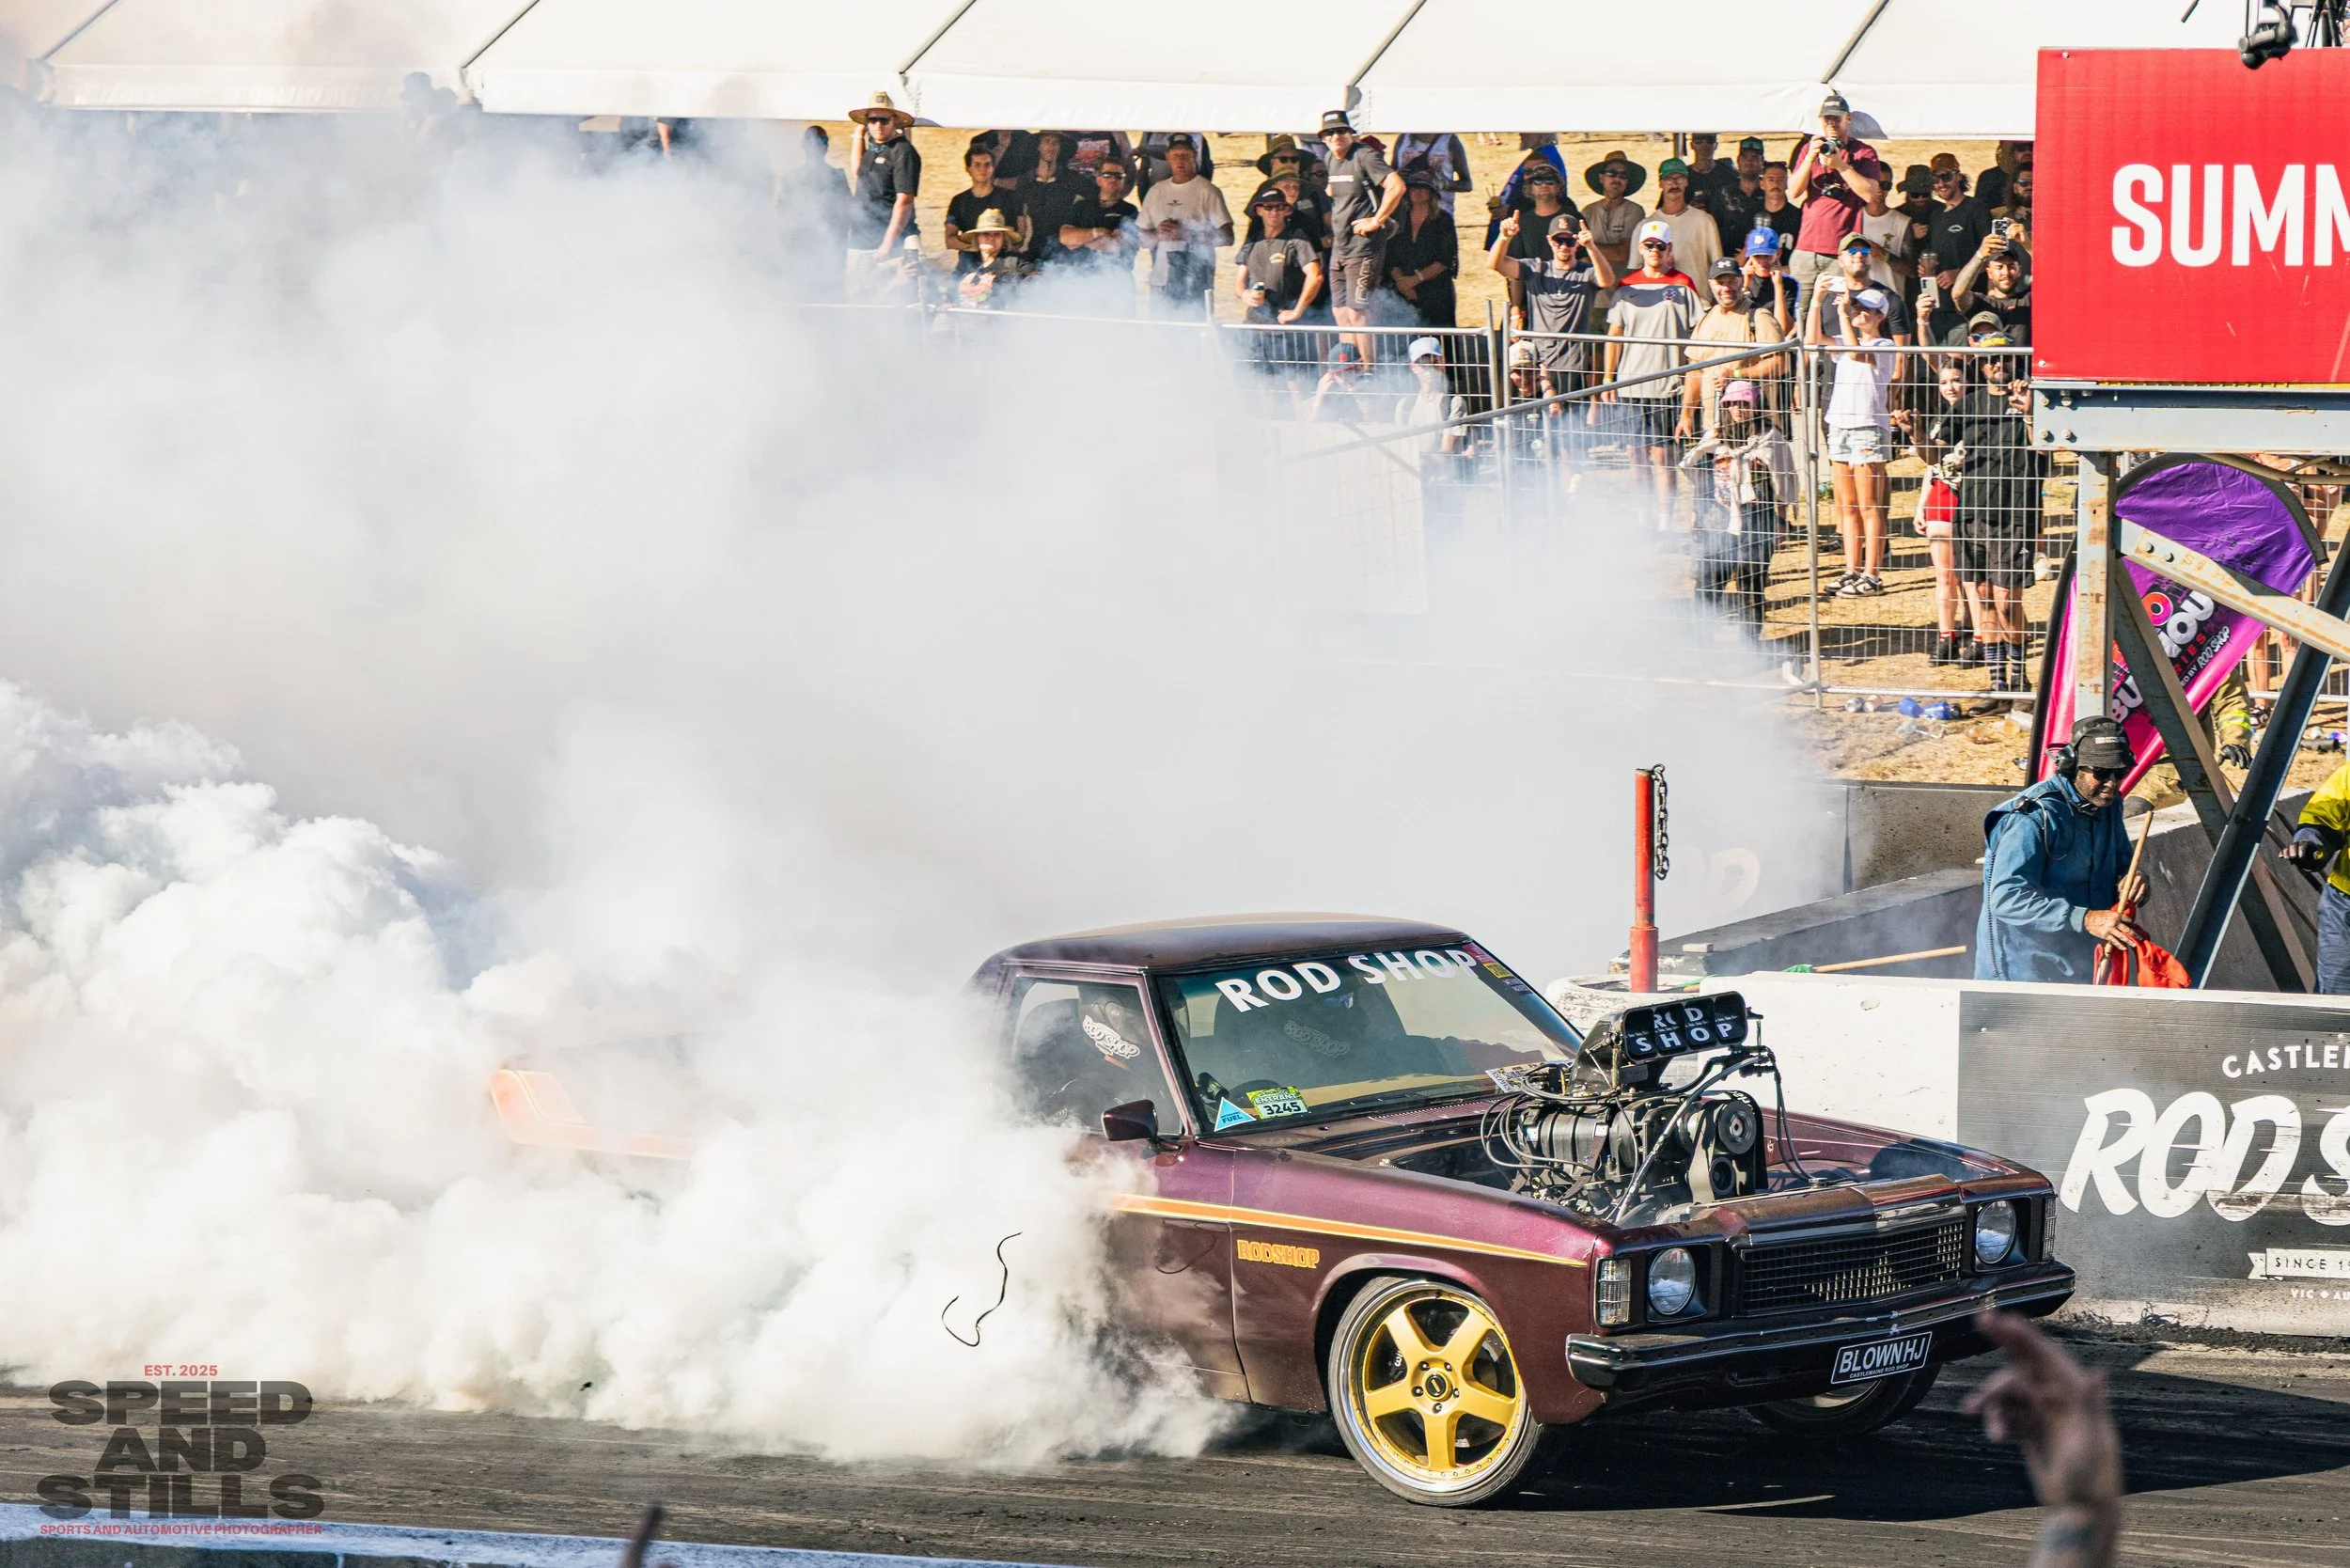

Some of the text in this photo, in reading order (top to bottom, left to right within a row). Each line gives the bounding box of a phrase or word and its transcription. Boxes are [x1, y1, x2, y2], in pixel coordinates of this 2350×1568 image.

[2197, 647, 2214, 668] ROD
[2211, 625, 2230, 652] SHOP
[1214, 962, 1341, 1013] ROD
[1348, 949, 1480, 985] SHOP
[1083, 1015, 1105, 1042] ROD
[1103, 1033, 1140, 1058] SHOP
[1636, 1023, 1732, 1052] SHOP
[1255, 1094, 1297, 1105] ENTRANT
[1263, 1102, 1301, 1116] 3245
[1222, 1114, 1243, 1123] FUEL
[2060, 1088, 2302, 1222] ROD
[1237, 1239, 1320, 1269] RODSHOP
[2276, 1257, 2350, 1271] SINCE 1
[2291, 1288, 2314, 1299] VIC
[1849, 1369, 1885, 1379] CASTLEMAINE
